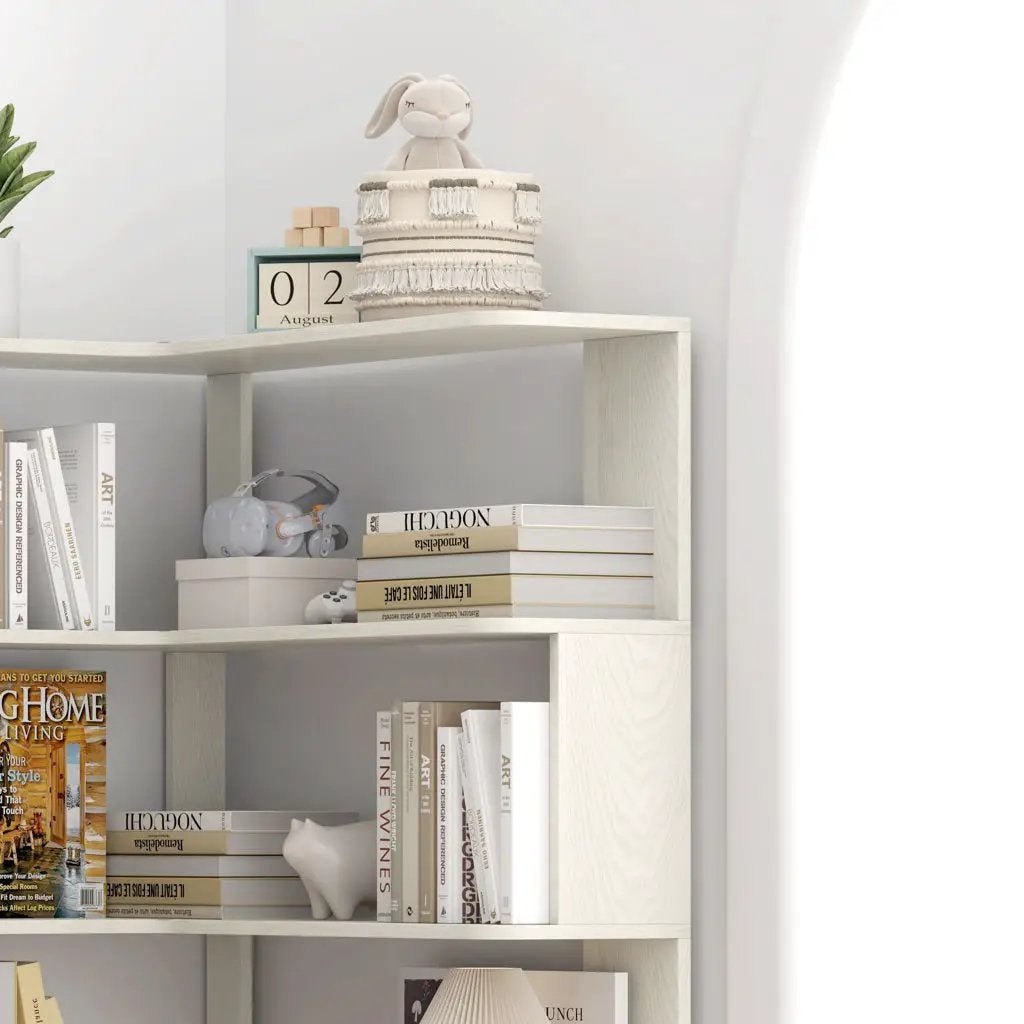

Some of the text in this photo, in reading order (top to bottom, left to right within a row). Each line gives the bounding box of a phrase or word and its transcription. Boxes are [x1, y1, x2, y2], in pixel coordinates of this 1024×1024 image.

[270, 269, 345, 306] 0 2
[280, 314, 335, 327] August
[101, 472, 114, 505] ART
[404, 508, 490, 532] NOGUCHI
[415, 537, 469, 551] Remodelista
[19, 674, 30, 682] TO
[32, 674, 47, 682] GET
[50, 674, 66, 682] YOU
[68, 674, 103, 683] STARTED
[5, 725, 64, 741] LIVING
[6, 756, 26, 767] YOUR
[379, 741, 391, 797] FINE
[7, 769, 41, 785] Style
[9, 785, 18, 794] to
[6, 795, 22, 804] That
[2, 806, 24, 815] Touch
[125, 812, 202, 830] NOGUCHI
[134, 839, 184, 851] Remodelista
[379, 809, 391, 894] WINES
[546, 1007, 581, 1021] UNCH
